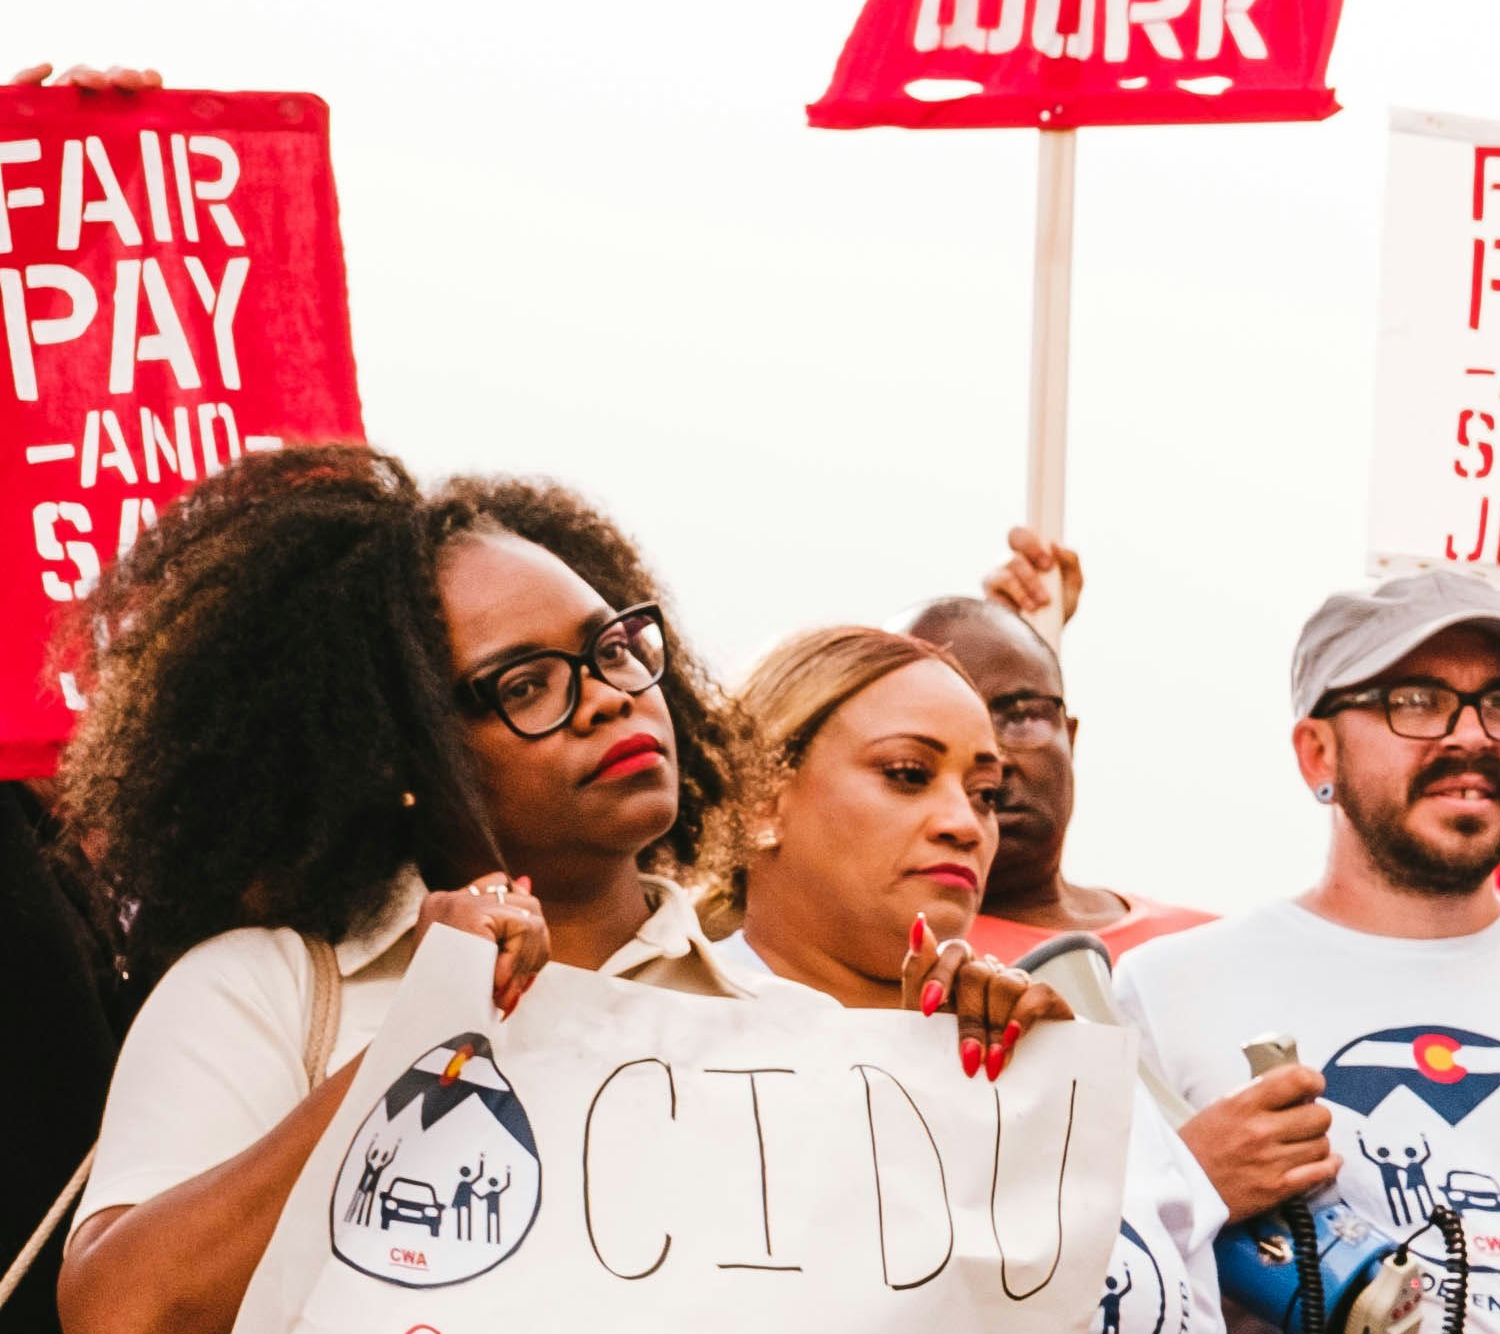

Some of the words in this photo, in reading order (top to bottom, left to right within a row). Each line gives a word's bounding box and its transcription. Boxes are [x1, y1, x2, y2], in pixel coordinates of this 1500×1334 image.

[0, 255, 251, 402] PAY
[583, 1056, 1080, 1302] CIDU
[390, 1247, 428, 1266] CWA
